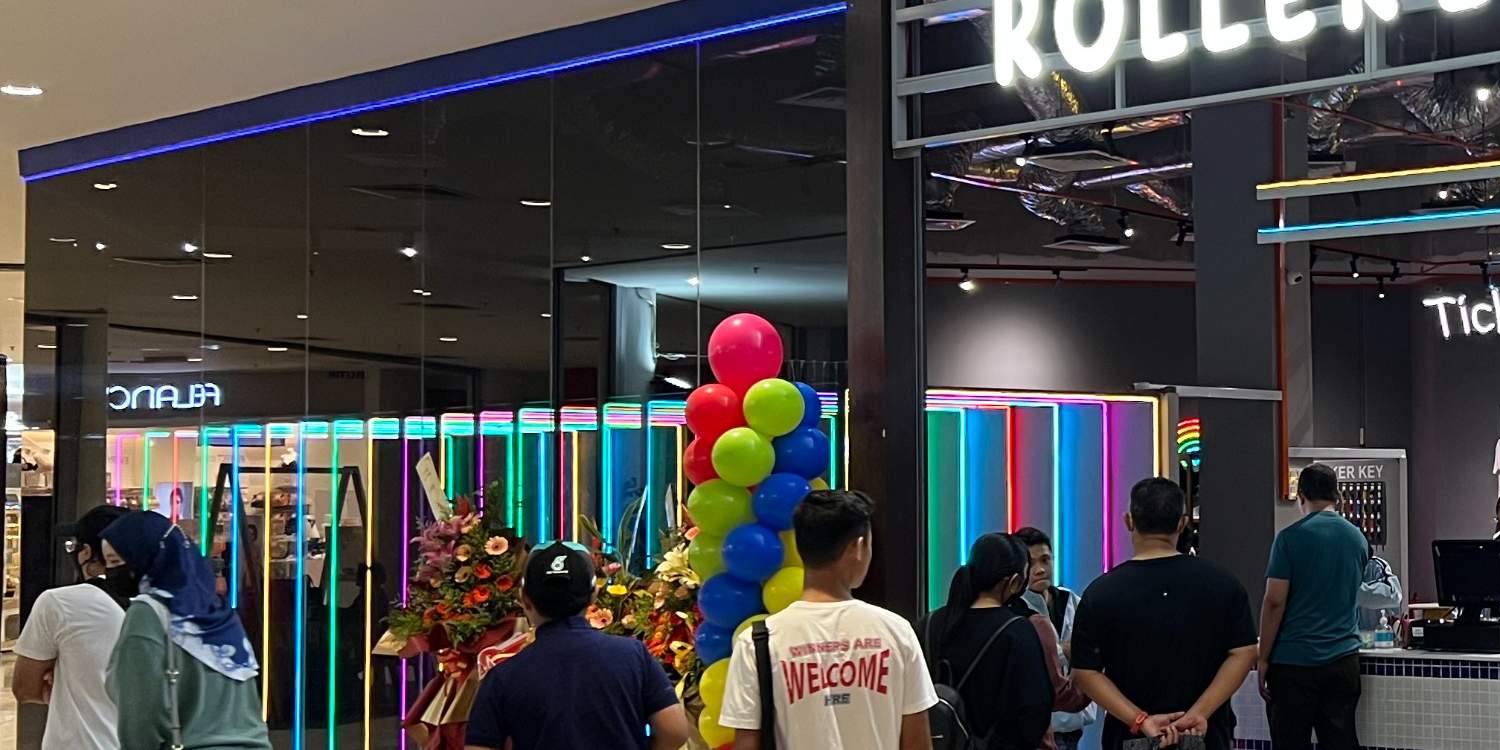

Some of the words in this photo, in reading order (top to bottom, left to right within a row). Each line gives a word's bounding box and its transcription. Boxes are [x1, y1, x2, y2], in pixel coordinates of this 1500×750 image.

[1358, 465, 1384, 479] KEY
[853, 638, 881, 650] ARE
[780, 649, 891, 705] WELCOME
